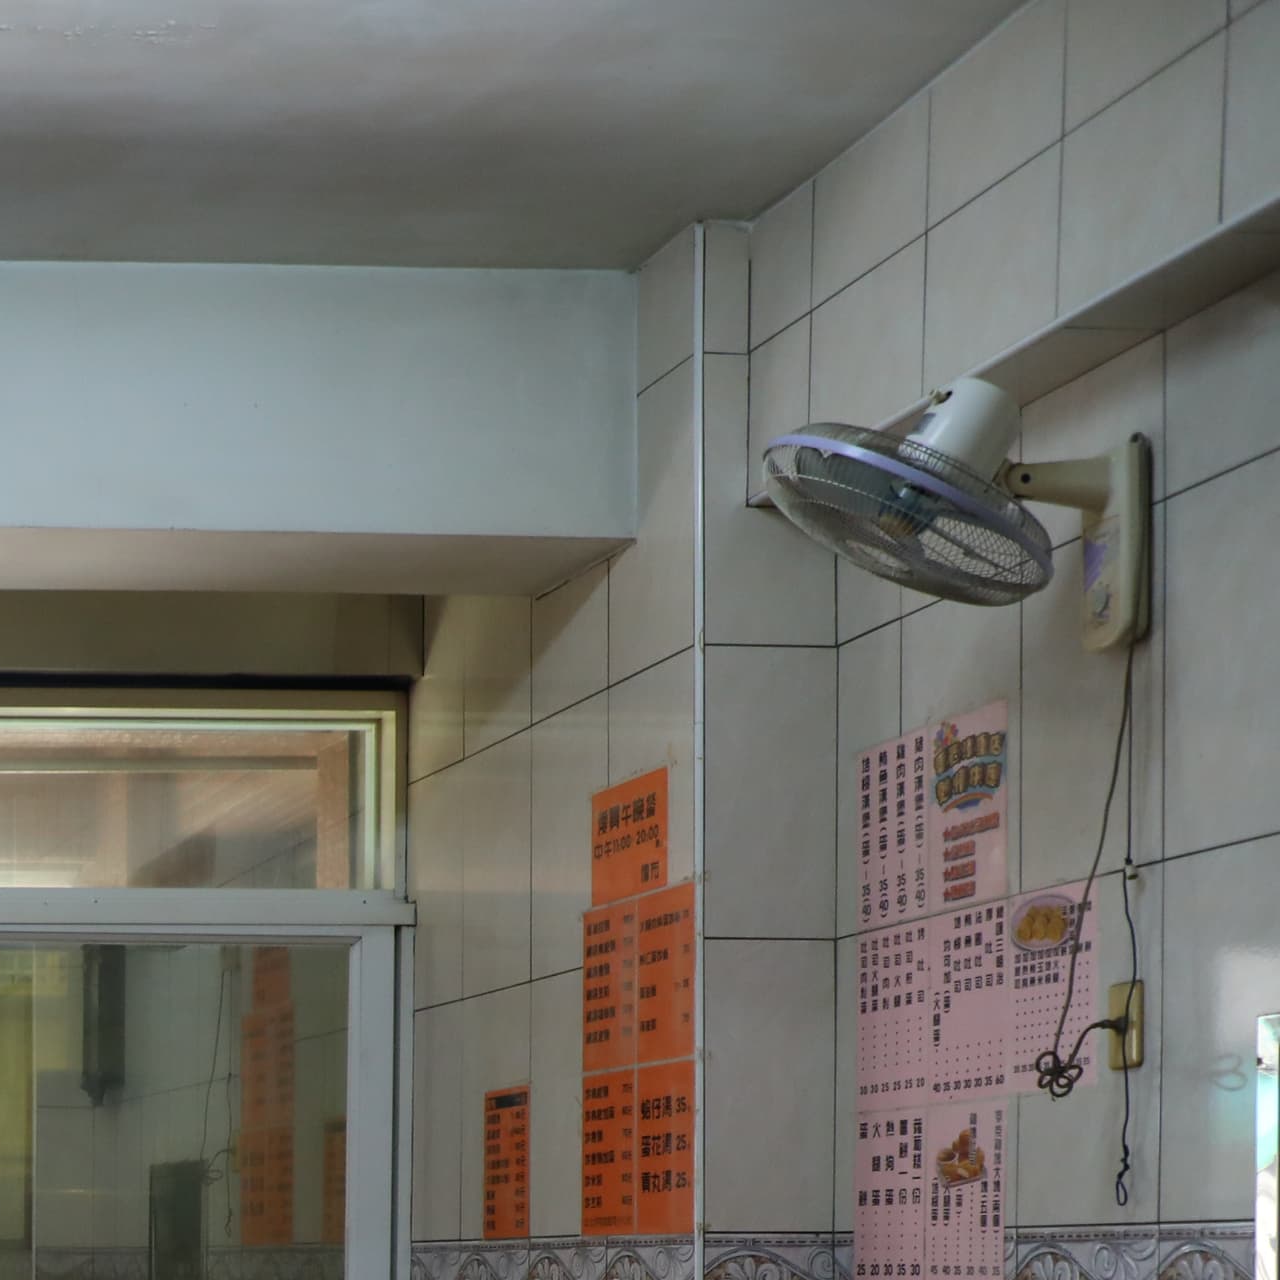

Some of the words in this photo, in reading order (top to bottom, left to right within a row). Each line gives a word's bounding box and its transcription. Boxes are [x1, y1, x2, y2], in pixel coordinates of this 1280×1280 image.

[856, 1264, 866, 1276] 25
[870, 1264, 880, 1276] 20
[883, 1264, 893, 1276] 30
[897, 1264, 906, 1276] 35
[910, 1264, 920, 1276] 30
